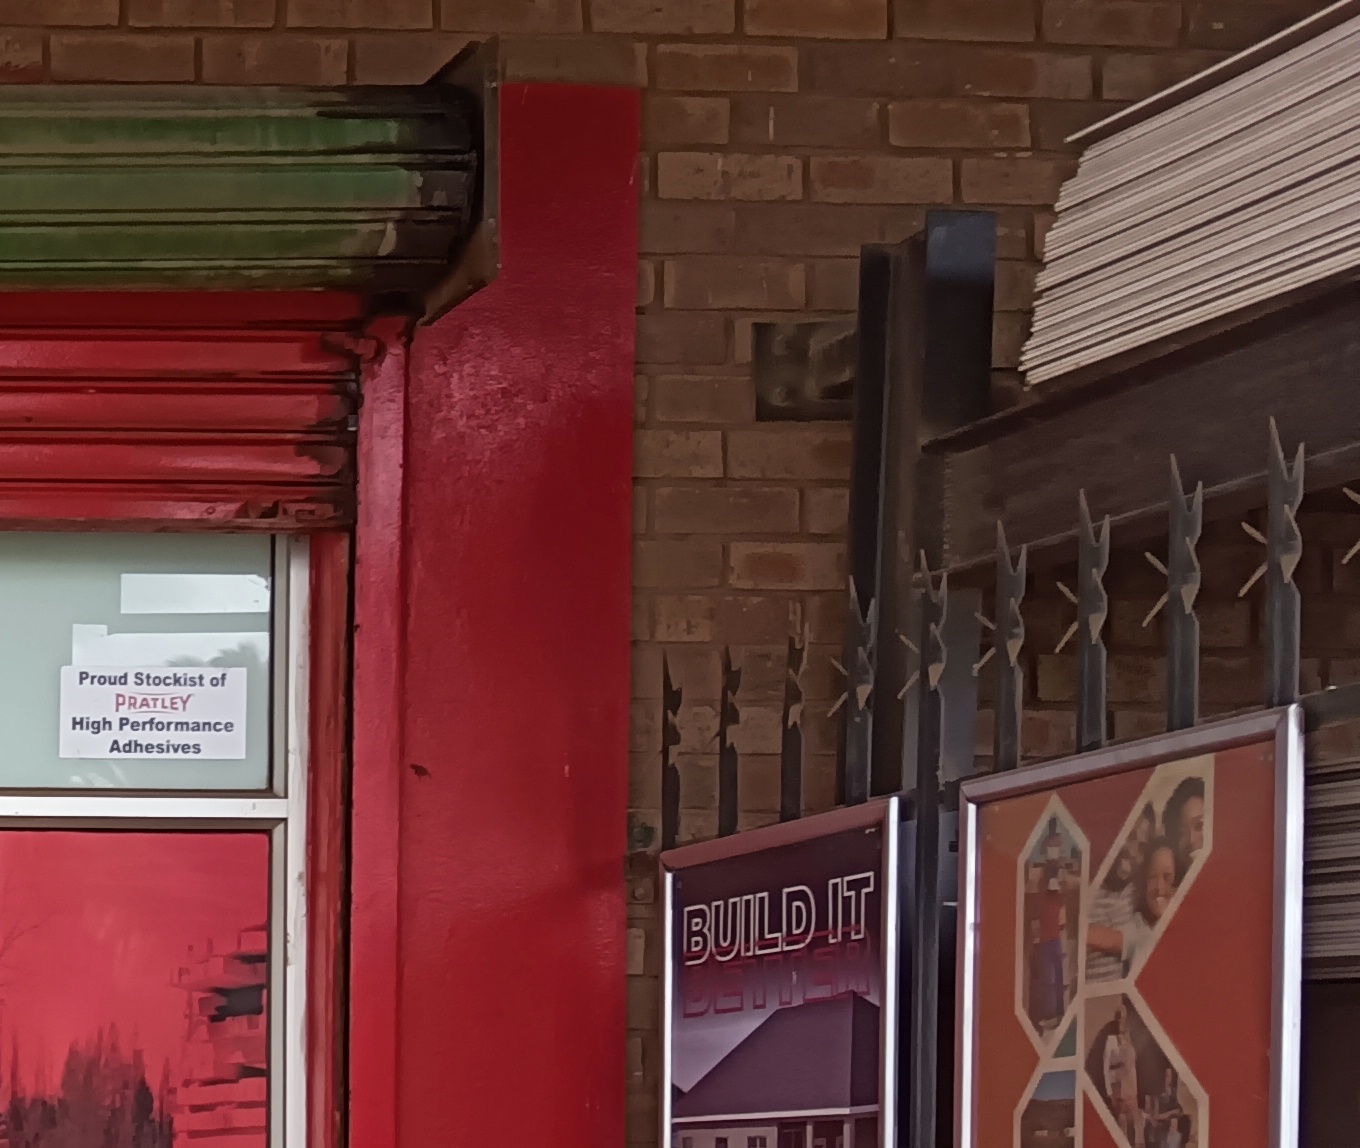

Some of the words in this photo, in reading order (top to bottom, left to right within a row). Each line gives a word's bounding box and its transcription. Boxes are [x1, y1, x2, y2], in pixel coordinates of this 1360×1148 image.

[78, 671, 128, 686] Proud
[133, 671, 205, 687] Stockist
[209, 672, 227, 687] of
[115, 693, 195, 713] PRATLEY
[71, 716, 113, 735] High
[118, 717, 234, 733] Performance
[108, 739, 202, 754] Adhesives
[683, 885, 817, 966] BUILD
[828, 871, 875, 944] IT
